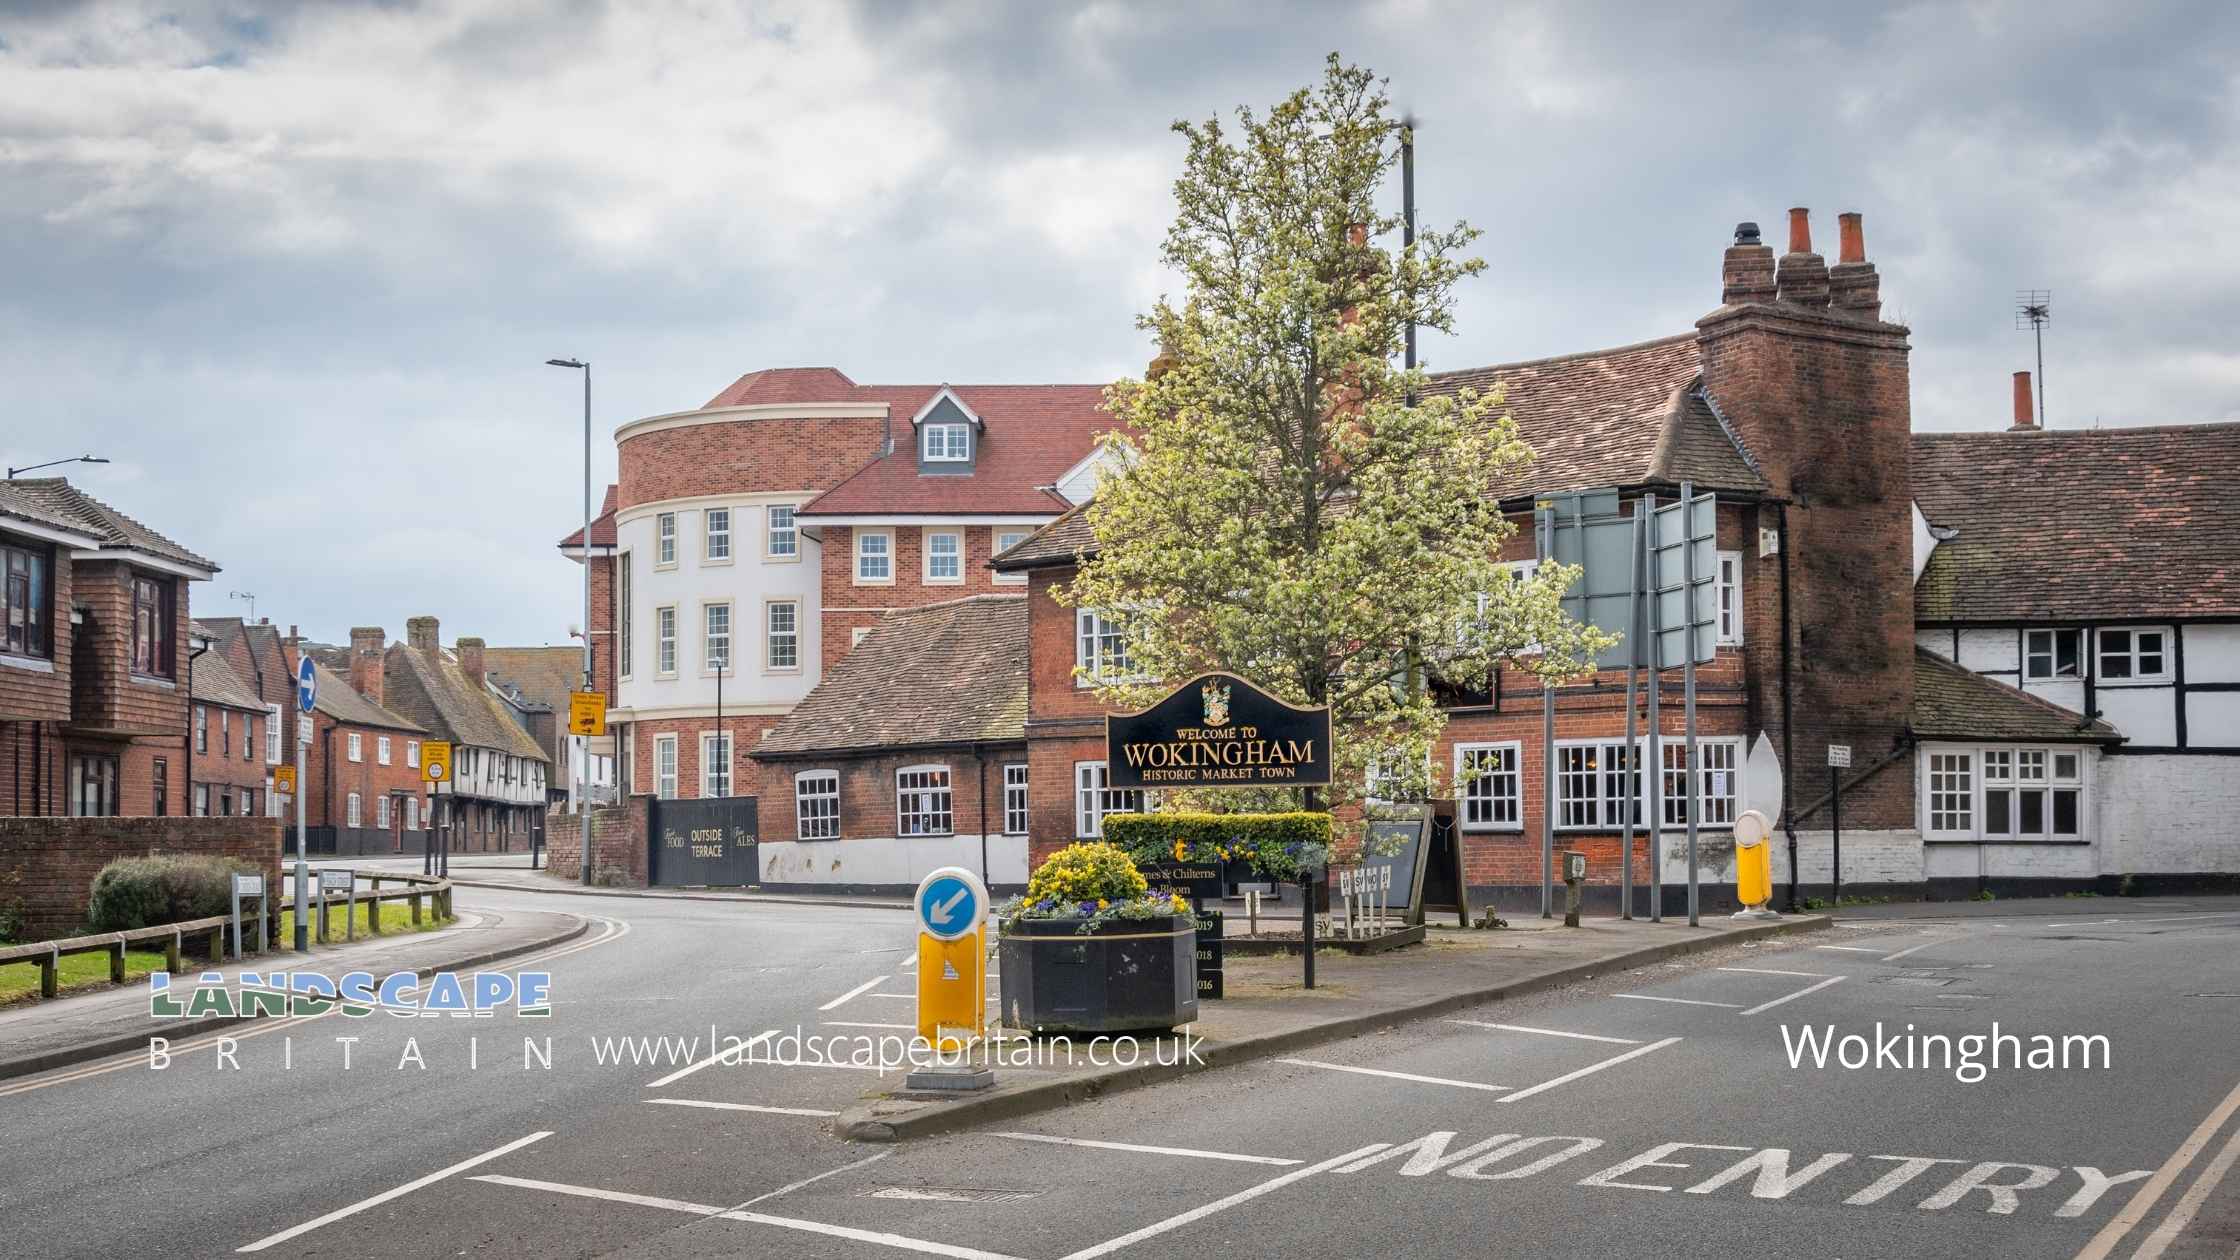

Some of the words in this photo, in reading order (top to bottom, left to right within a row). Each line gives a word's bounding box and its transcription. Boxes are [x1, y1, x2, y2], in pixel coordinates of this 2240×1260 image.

[1177, 728, 1236, 740] WELCOME
[1241, 727, 1257, 738] TO
[1123, 739, 1315, 768] WOKINGHAM
[1143, 769, 1197, 781] HISTORIC
[1202, 768, 1253, 779] MARKET
[1259, 767, 1296, 778] TOWN
[691, 828, 722, 842] OUTSIDE
[736, 835, 755, 847] ALES
[691, 845, 722, 858] TERRACE
[1142, 871, 1161, 880] mes
[1173, 868, 1216, 879] Chilterns
[1355, 875, 1364, 887] SV
[1160, 884, 1191, 896] Bloom
[1194, 920, 1214, 931] 019
[1315, 920, 1330, 930] SV
[1196, 950, 1213, 960] 018
[1197, 980, 1213, 990] 016
[1331, 1131, 1604, 1180] NO
[1578, 1142, 2154, 1217] ENTRY
